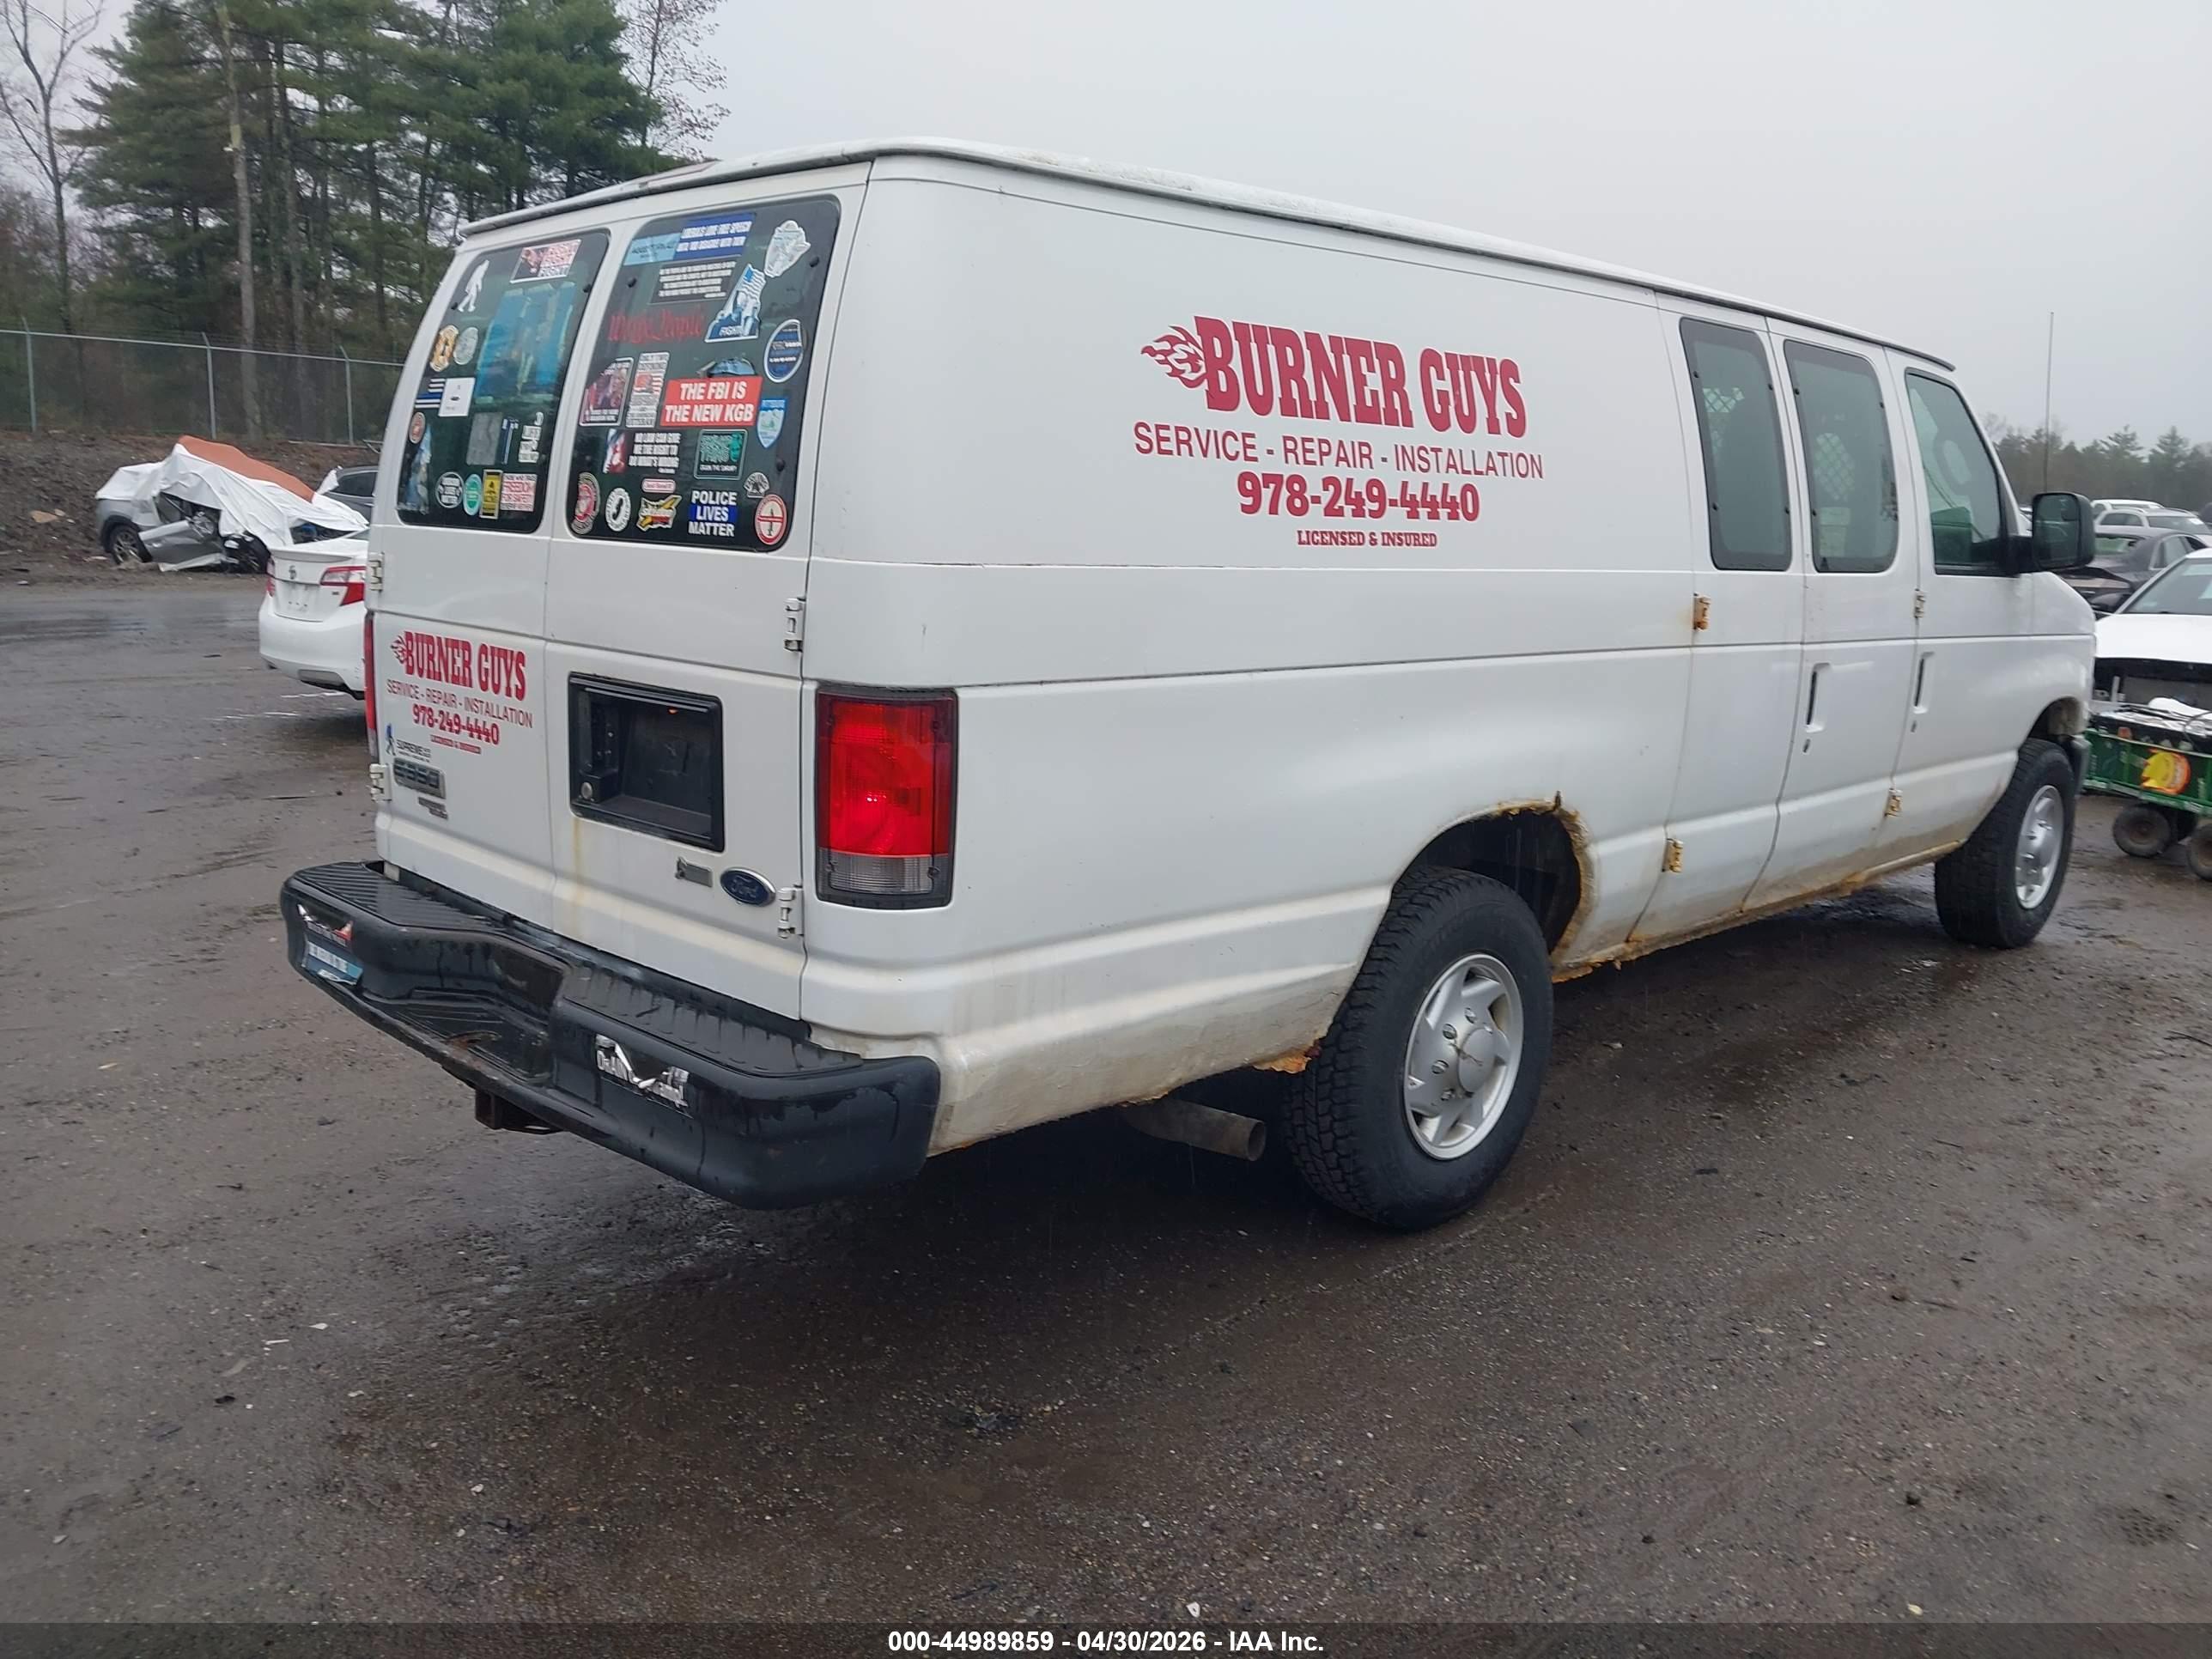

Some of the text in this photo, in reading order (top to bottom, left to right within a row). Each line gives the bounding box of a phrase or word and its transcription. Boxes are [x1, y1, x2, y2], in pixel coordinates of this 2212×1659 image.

[680, 381, 745, 400] THE FBI IS
[1194, 315, 1526, 438] BURNER GUYS
[665, 405, 690, 422] THE
[691, 404, 723, 422] NEW
[724, 404, 755, 422] KGB
[1134, 422, 1257, 462] SERVICE
[1284, 435, 1374, 469] REPAIR
[1395, 444, 1544, 479] INSTALLATION
[691, 490, 738, 506] POLICE
[1237, 471, 1480, 521] 978-249-4440
[688, 520, 735, 537] MATTER
[696, 506, 729, 521] LIVES
[1297, 531, 1437, 547] LICENSED & INSURED
[404, 631, 526, 701] BURNER GUYS
[387, 679, 420, 701] SERVICE
[426, 689, 457, 708] REPAIR
[465, 696, 532, 728] INSTALLATION
[413, 703, 500, 745] 978-249-4440
